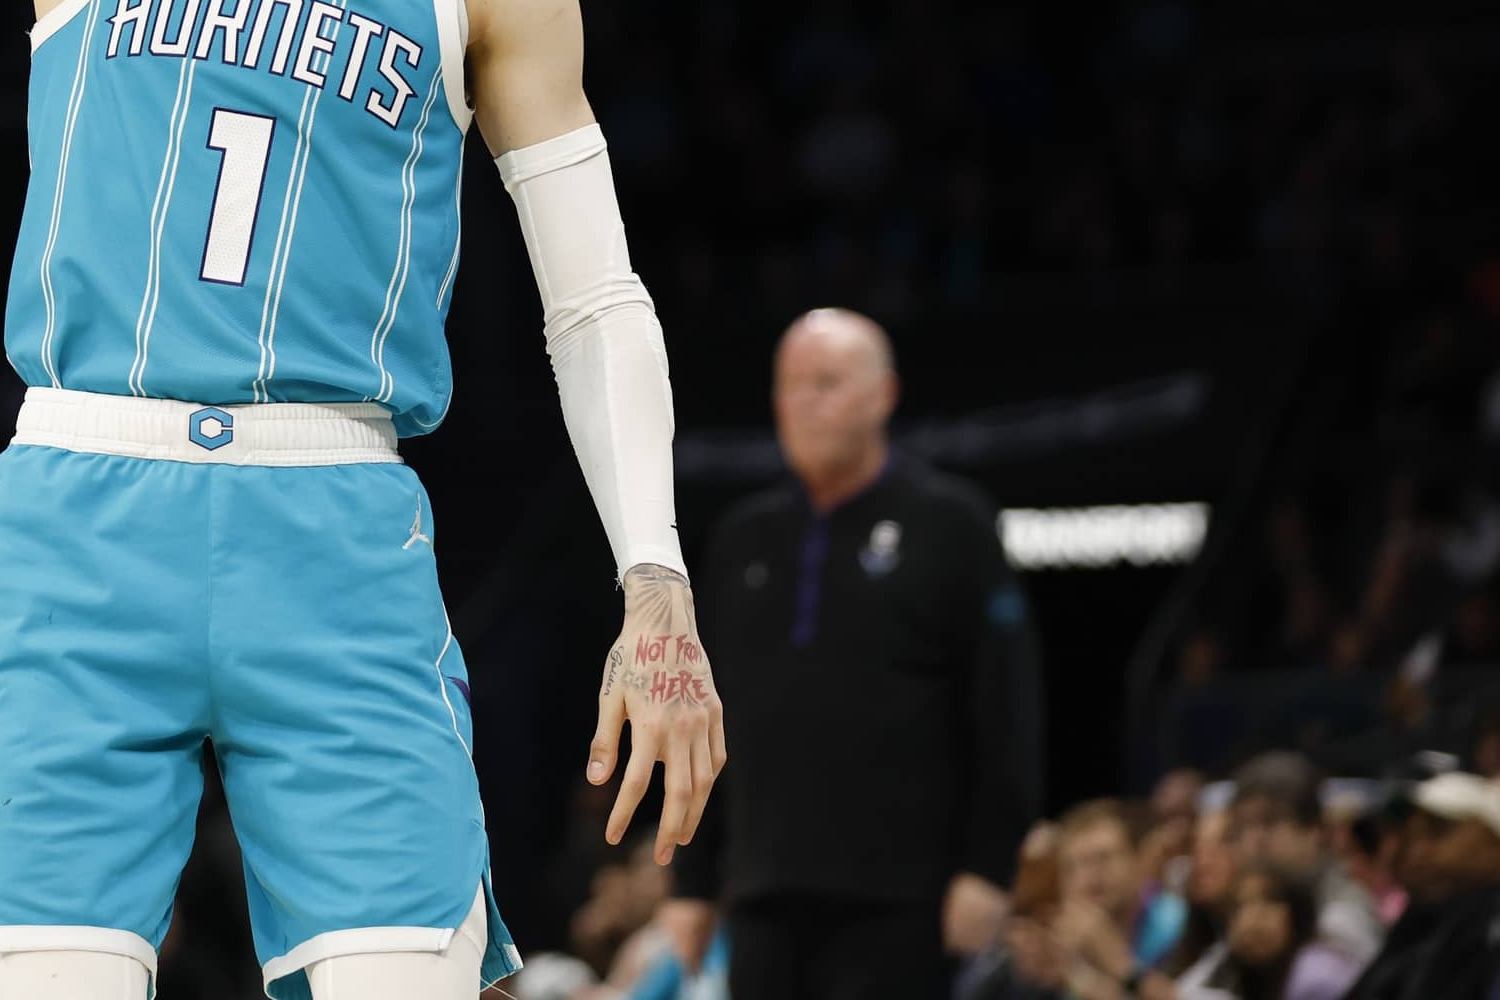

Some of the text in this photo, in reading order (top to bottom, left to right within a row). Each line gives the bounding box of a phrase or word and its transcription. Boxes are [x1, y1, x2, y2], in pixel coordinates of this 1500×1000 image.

[199, 106, 276, 287] 1
[635, 633, 672, 667] NOT
[650, 670, 708, 704] HERE
